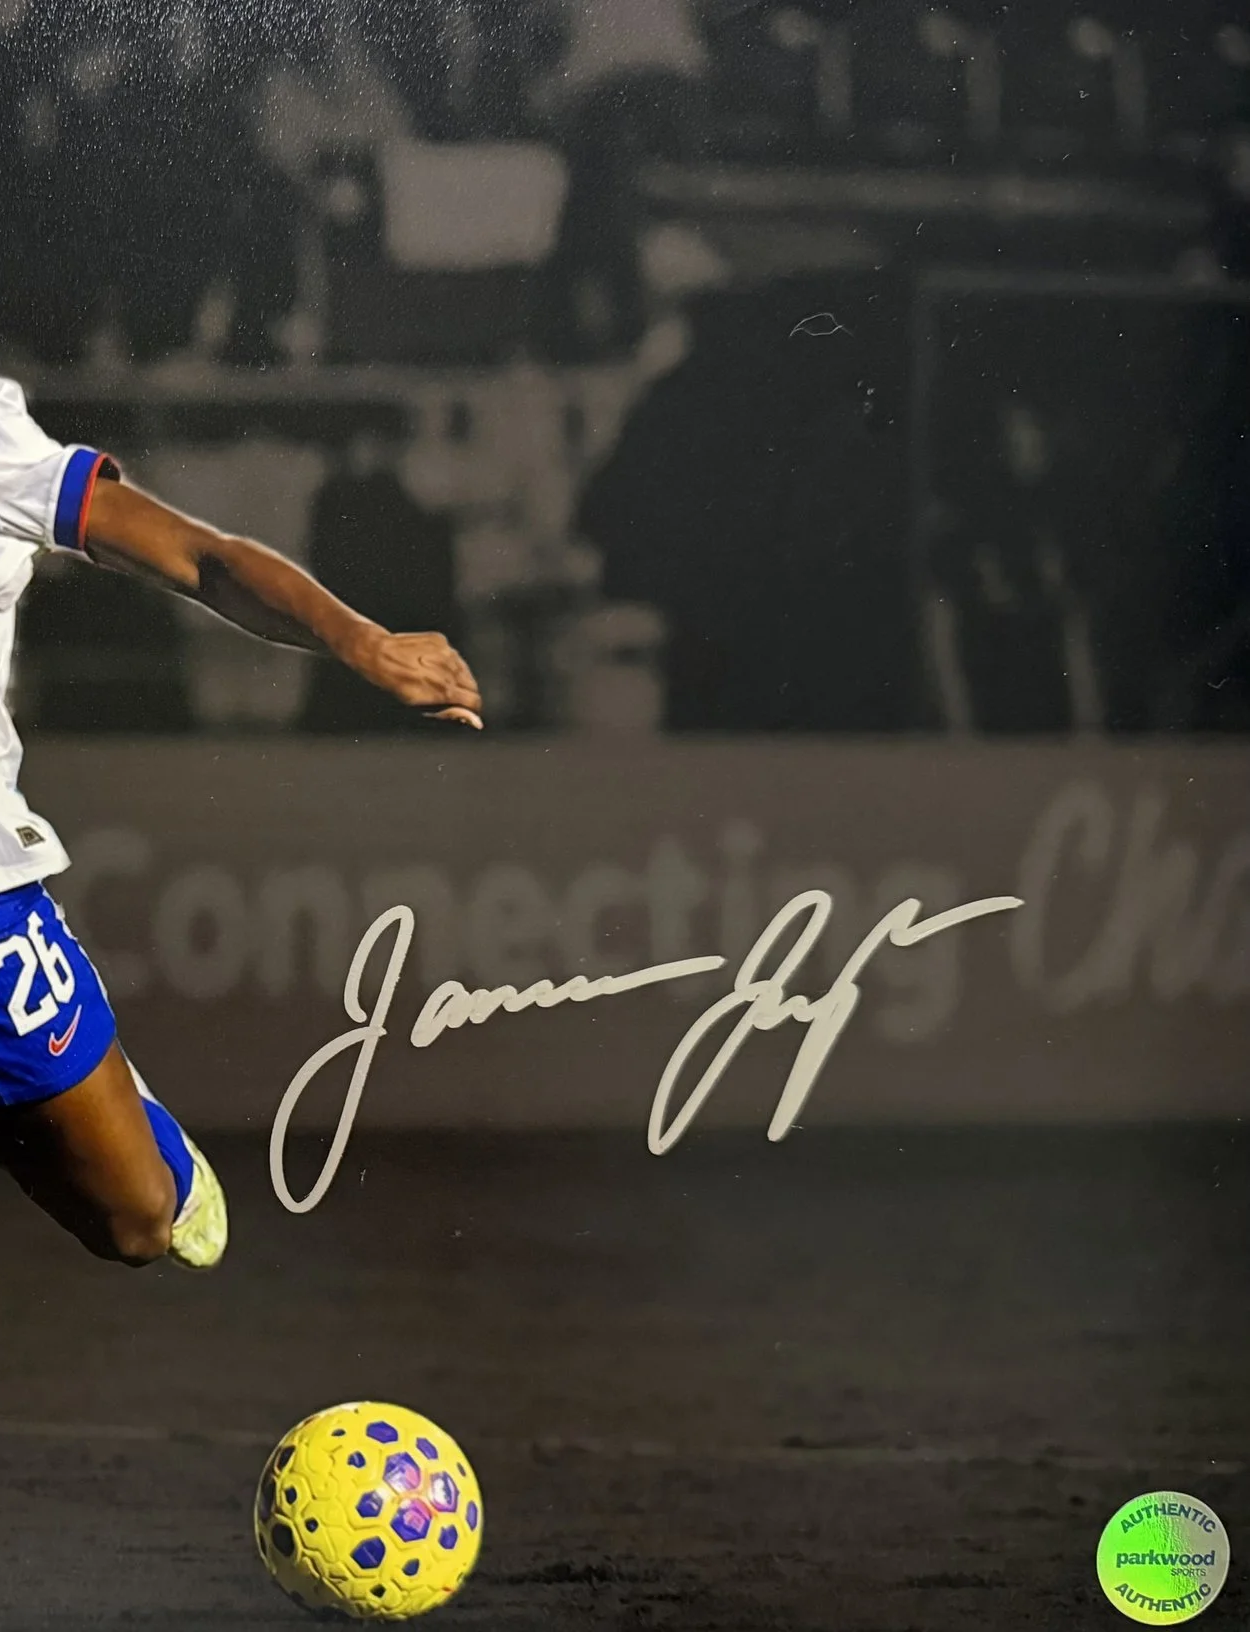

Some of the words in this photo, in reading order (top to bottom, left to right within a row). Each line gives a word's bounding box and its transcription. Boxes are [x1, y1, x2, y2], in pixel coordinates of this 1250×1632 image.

[62, 824, 963, 1047] Connecting
[1120, 1502, 1217, 1534] AUTHENTIC
[1115, 1549, 1216, 1569] parkwood
[1170, 1568, 1207, 1577] SPORTS
[1114, 1582, 1213, 1613] AUTHENTIC
